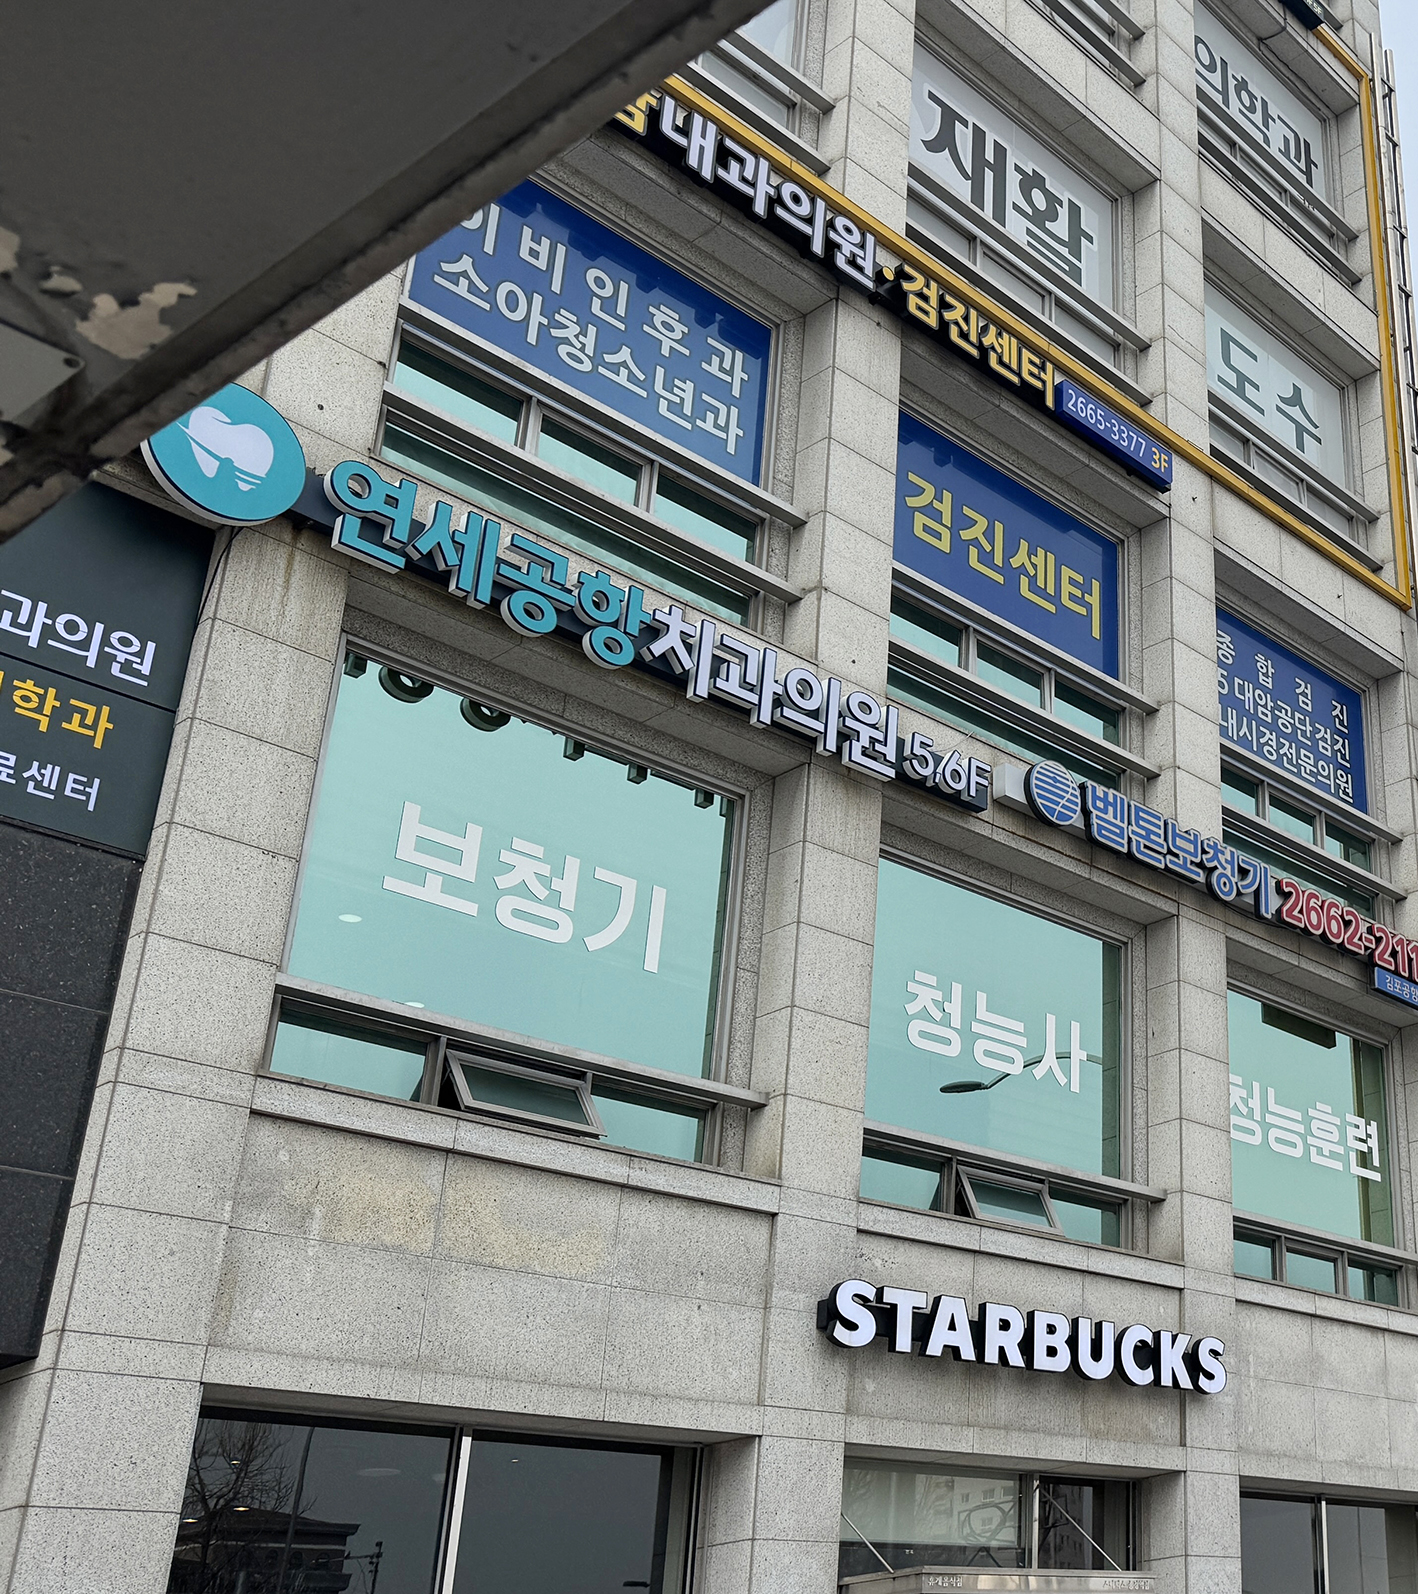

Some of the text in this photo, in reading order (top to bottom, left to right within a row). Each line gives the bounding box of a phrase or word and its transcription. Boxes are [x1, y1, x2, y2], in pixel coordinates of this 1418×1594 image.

[920, 89, 1094, 287] 재활
[433, 254, 744, 456] 소아청소년과
[1217, 327, 1322, 456] 도수
[1067, 389, 1169, 473] 2665-3377 3F
[323, 459, 899, 783] 연세공항치과의원
[905, 471, 1100, 640] 검진센터
[0, 670, 114, 749] 학과
[382, 801, 667, 974] 보청기
[1086, 782, 1273, 920] 벨톤보청기
[904, 970, 1088, 1093] 청능사
[1230, 1073, 1382, 1182] 청능훈련
[830, 1280, 1228, 1394] STARBUCKS
